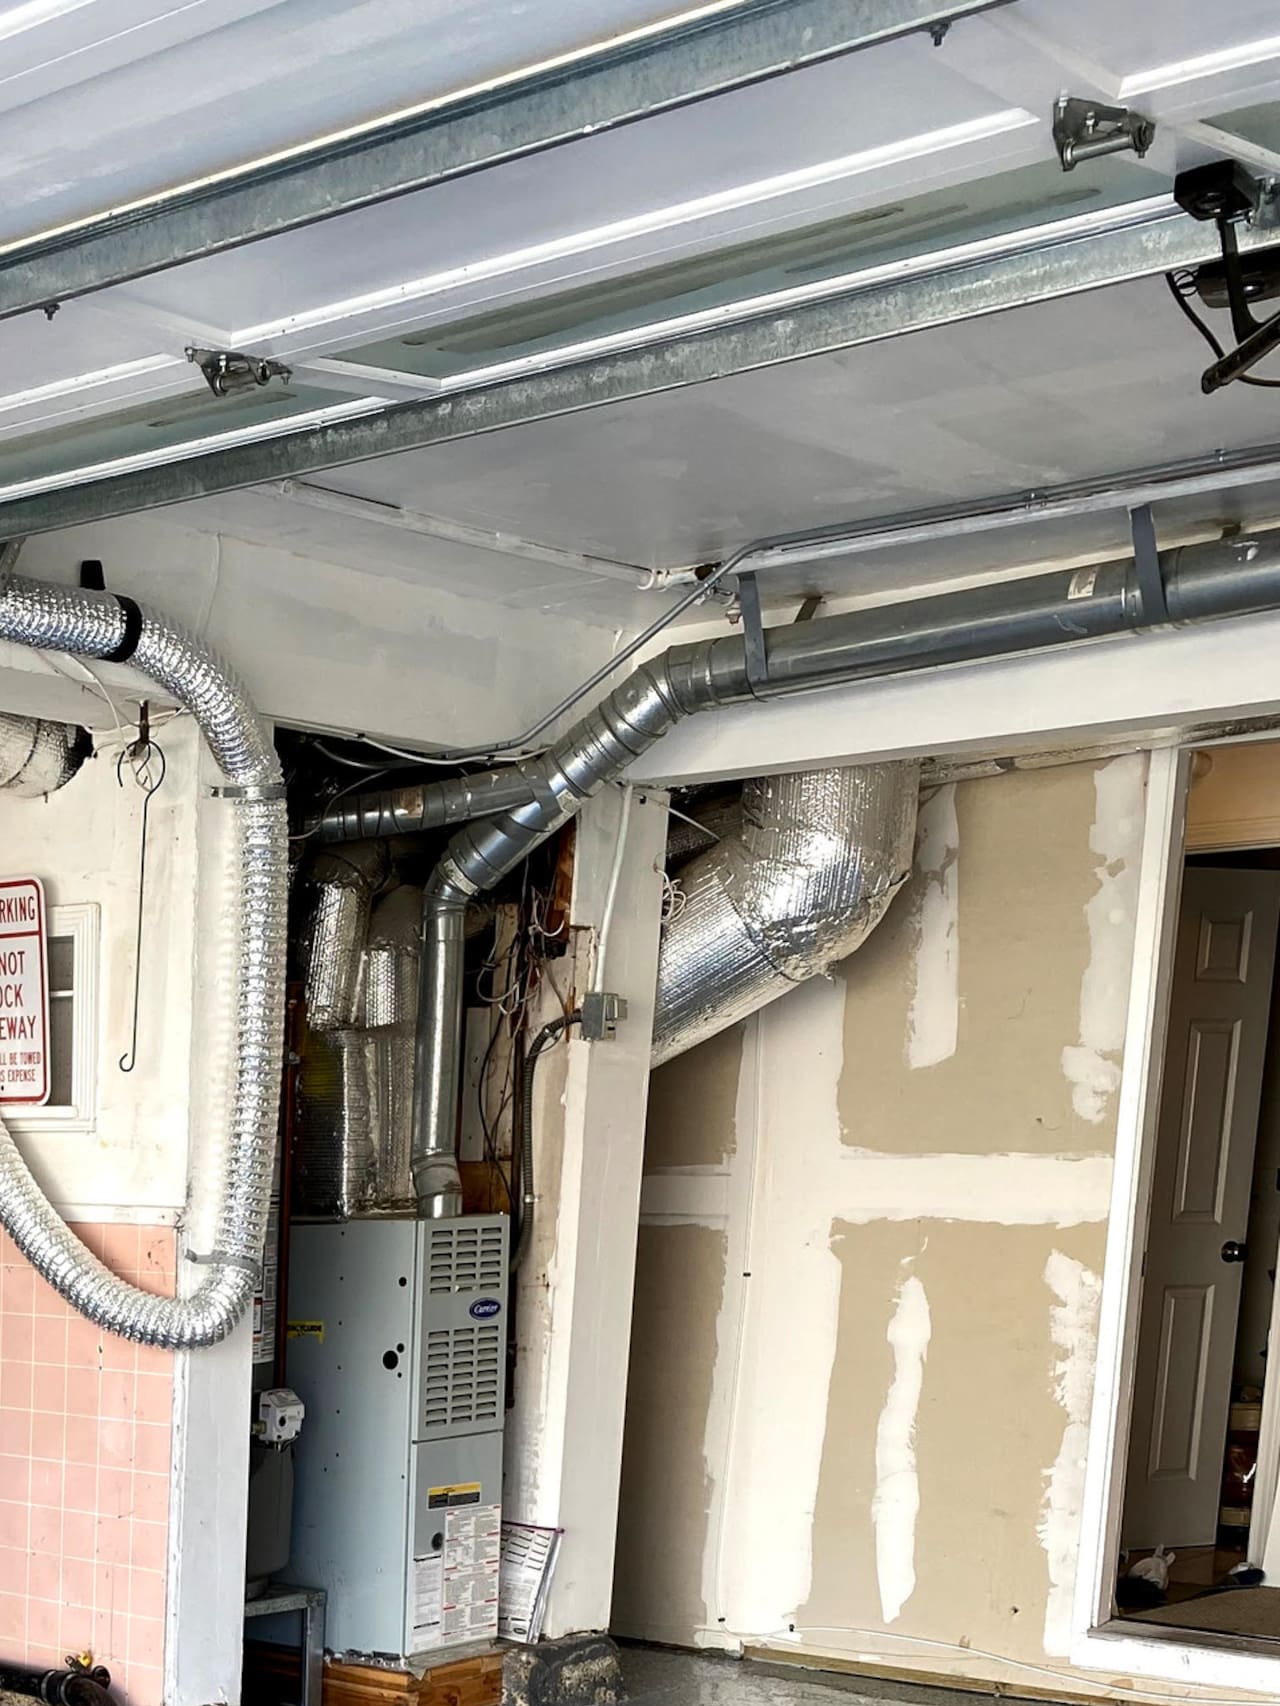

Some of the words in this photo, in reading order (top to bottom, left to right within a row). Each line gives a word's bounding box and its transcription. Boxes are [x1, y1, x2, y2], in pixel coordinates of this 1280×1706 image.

[9, 1052, 18, 1065] BE
[20, 1051, 41, 1065] TOWED
[7, 1069, 36, 1082] EXPENSE
